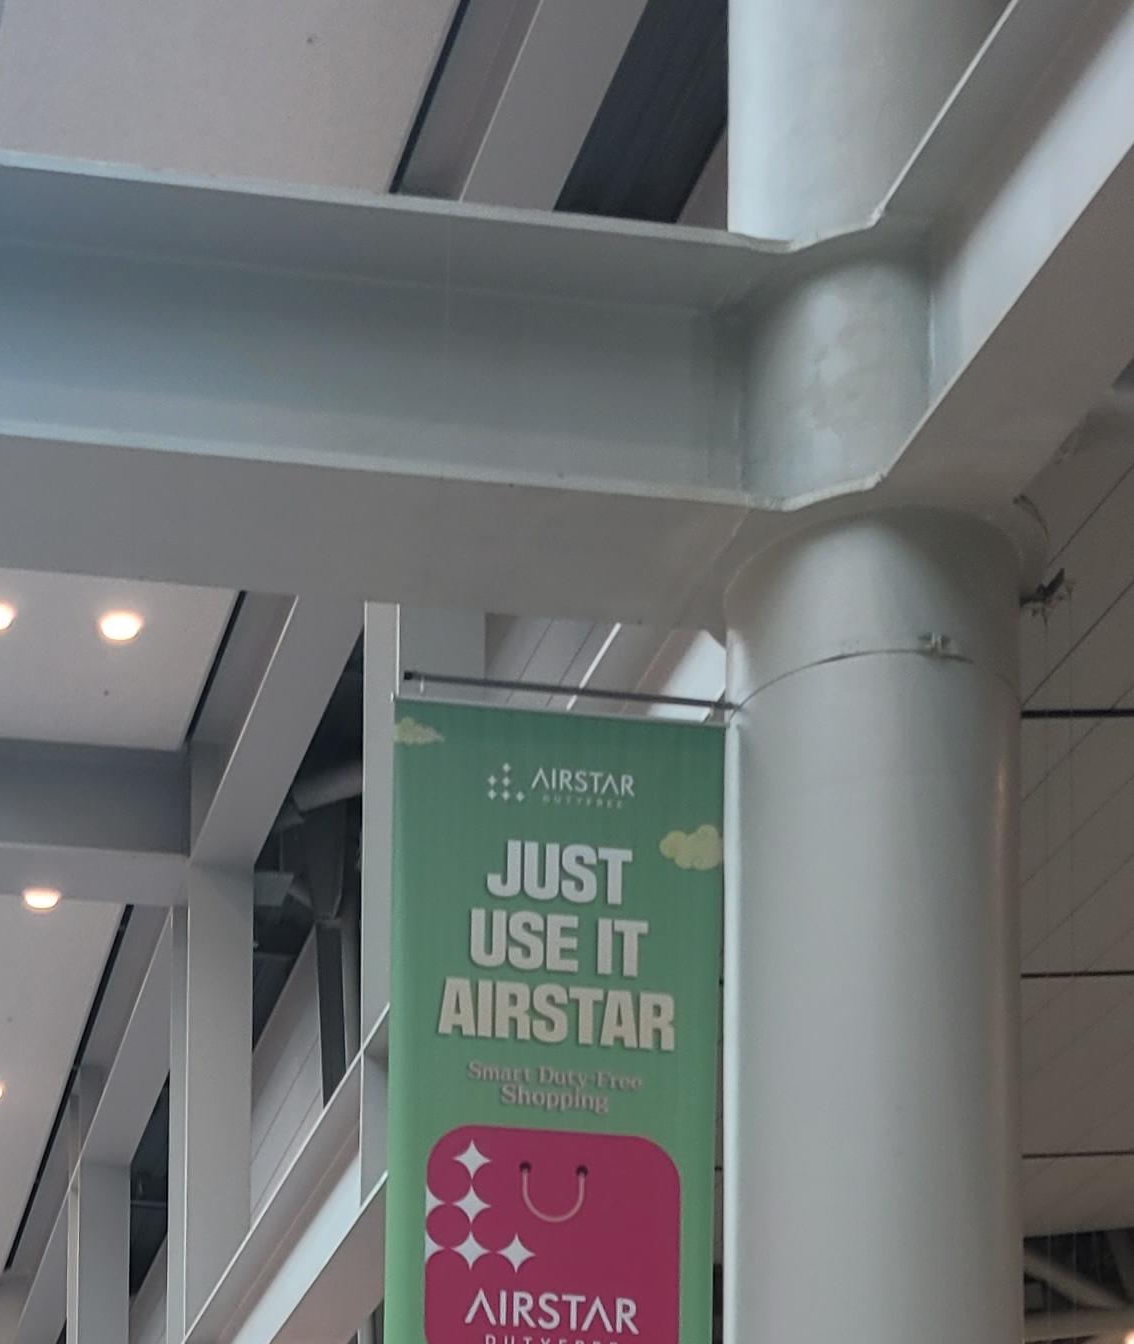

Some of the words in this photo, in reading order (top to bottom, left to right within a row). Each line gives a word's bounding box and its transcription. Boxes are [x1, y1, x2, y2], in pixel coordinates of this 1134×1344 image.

[531, 766, 635, 797] AIRSTAR
[487, 839, 633, 905] JUST
[470, 908, 579, 973] USE
[597, 918, 649, 977] IT
[438, 976, 675, 1051] AIRSTAR
[468, 1060, 531, 1082] Smart
[501, 1083, 609, 1115] Shopping
[465, 1288, 640, 1335] AIRSTAR
